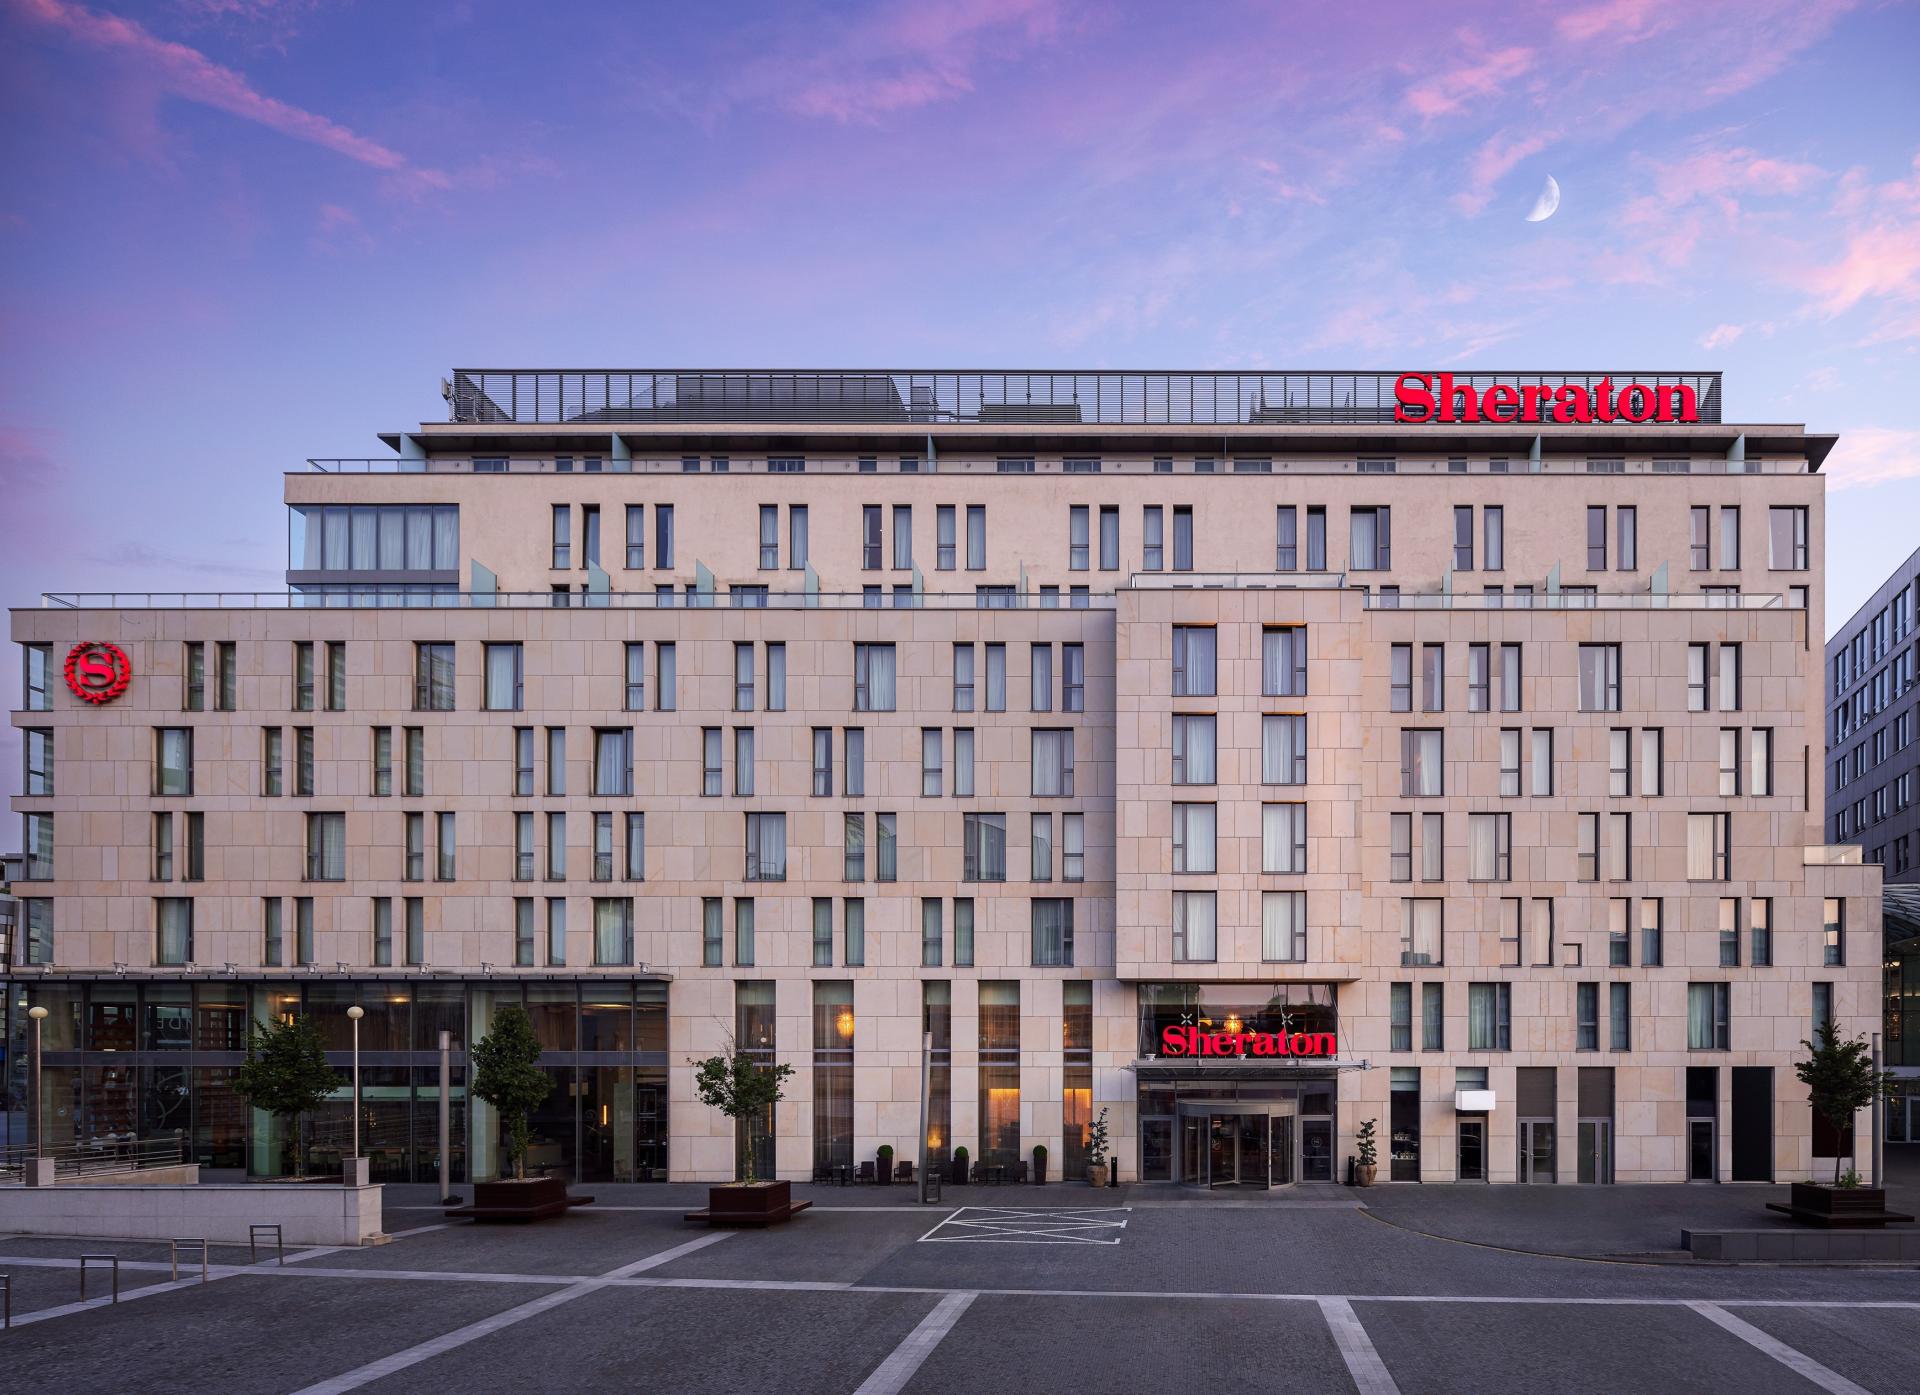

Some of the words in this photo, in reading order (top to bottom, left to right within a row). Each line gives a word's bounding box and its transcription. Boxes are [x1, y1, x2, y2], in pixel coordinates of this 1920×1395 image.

[1394, 372, 1700, 423] Sheraton
[80, 651, 115, 687] S
[1163, 1026, 1337, 1056] Sheraton
